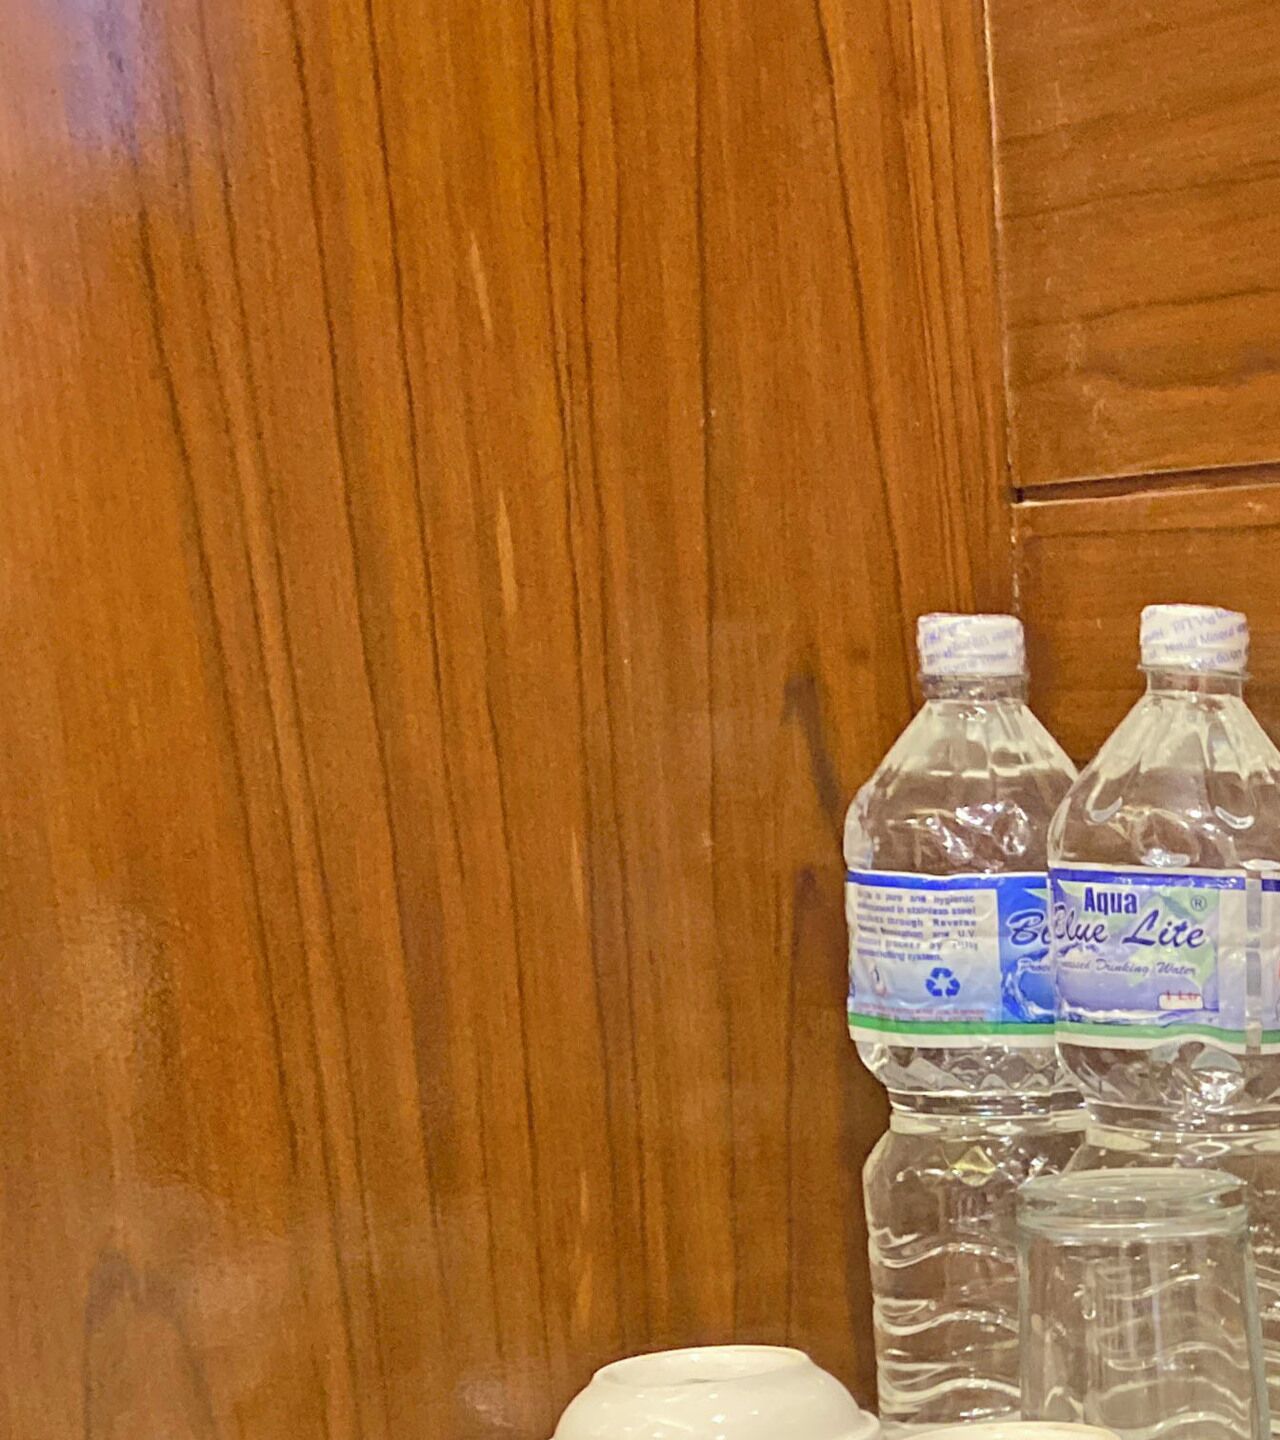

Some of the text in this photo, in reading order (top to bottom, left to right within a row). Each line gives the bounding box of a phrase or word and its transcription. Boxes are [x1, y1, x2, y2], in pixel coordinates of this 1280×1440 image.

[951, 906, 976, 915] steel
[1084, 887, 1138, 916] Aqua
[932, 918, 977, 927] Reverse
[1122, 910, 1207, 949] Lite
[1095, 958, 1150, 977] Drinking
[1156, 961, 1197, 977] Water
